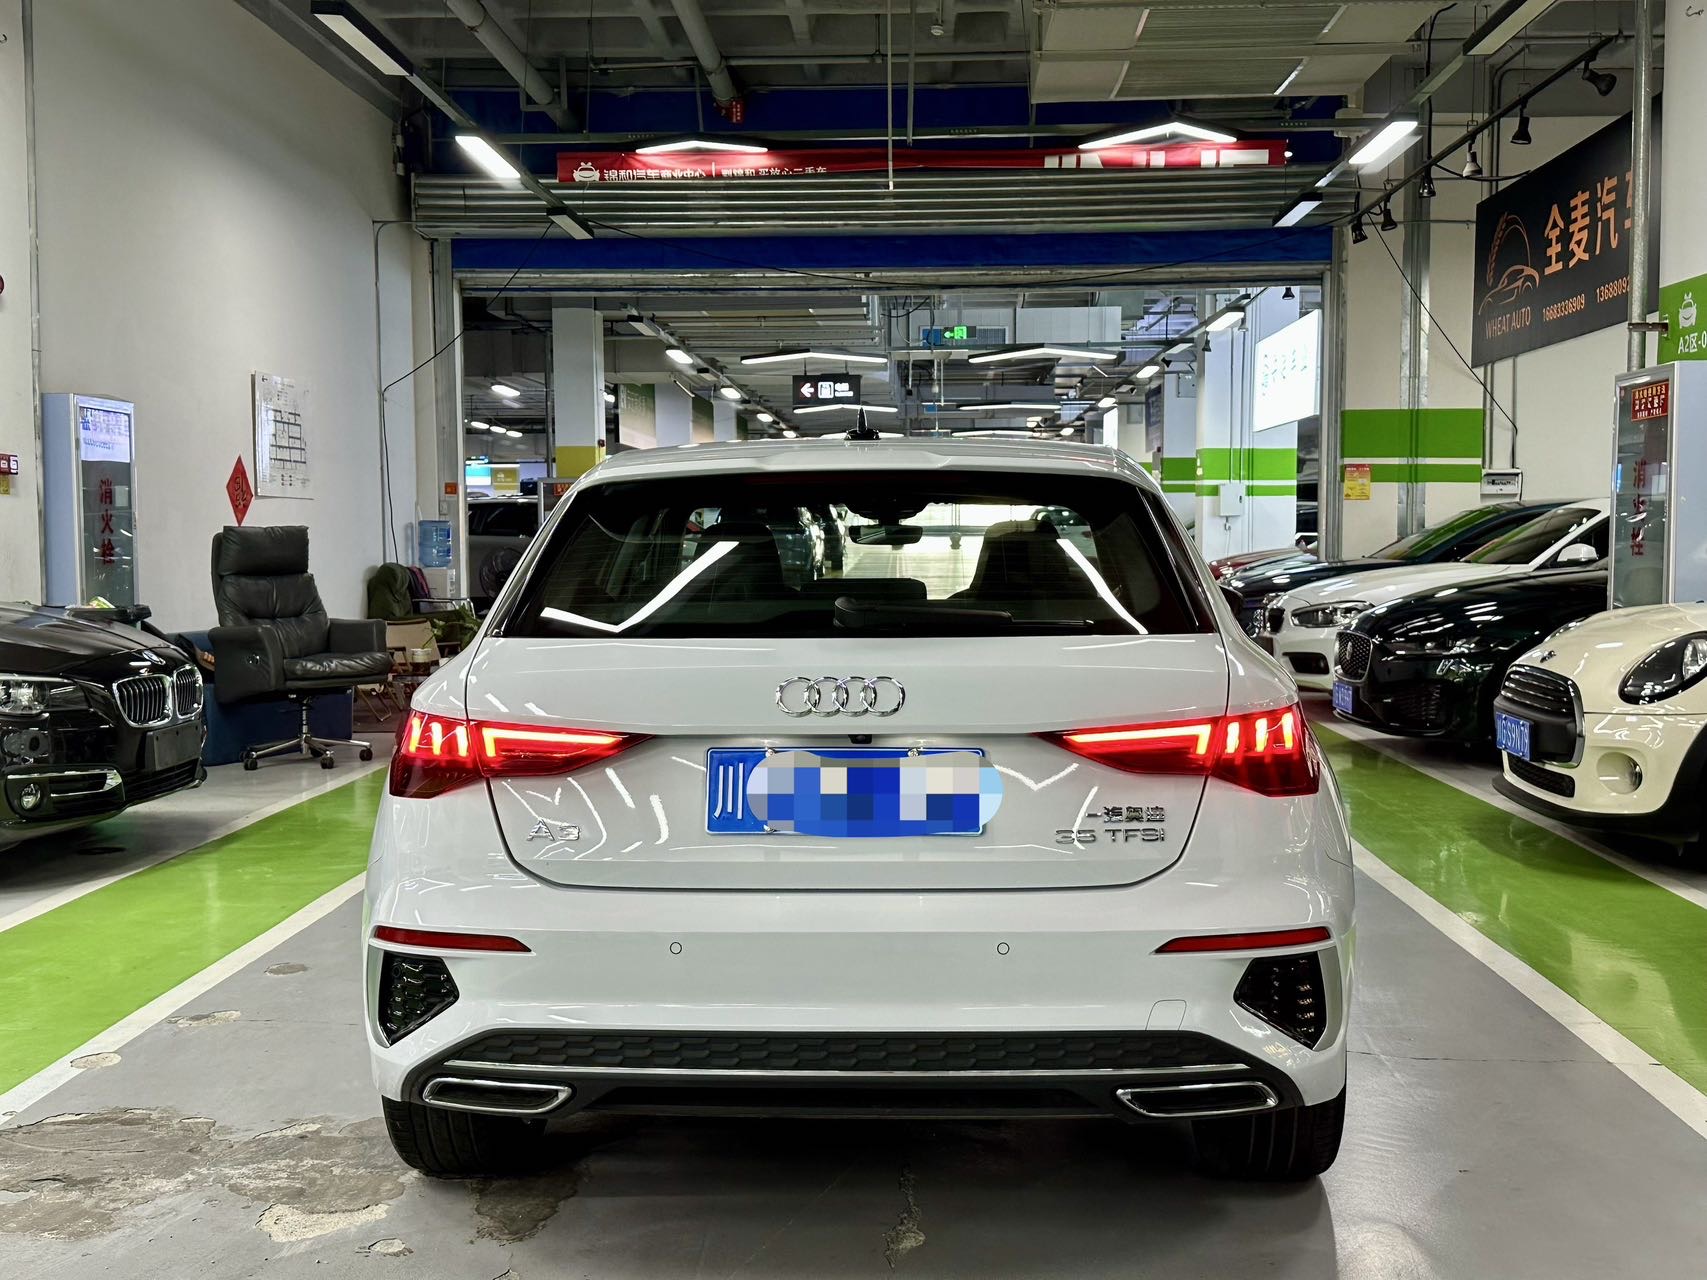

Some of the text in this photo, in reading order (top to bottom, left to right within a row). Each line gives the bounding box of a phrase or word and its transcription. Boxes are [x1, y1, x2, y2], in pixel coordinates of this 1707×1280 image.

[1485, 306, 1531, 340] WHEAT AUTO
[100, 478, 115, 565] 消火栓
[526, 818, 580, 841] A3
[1056, 829, 1096, 844] 35
